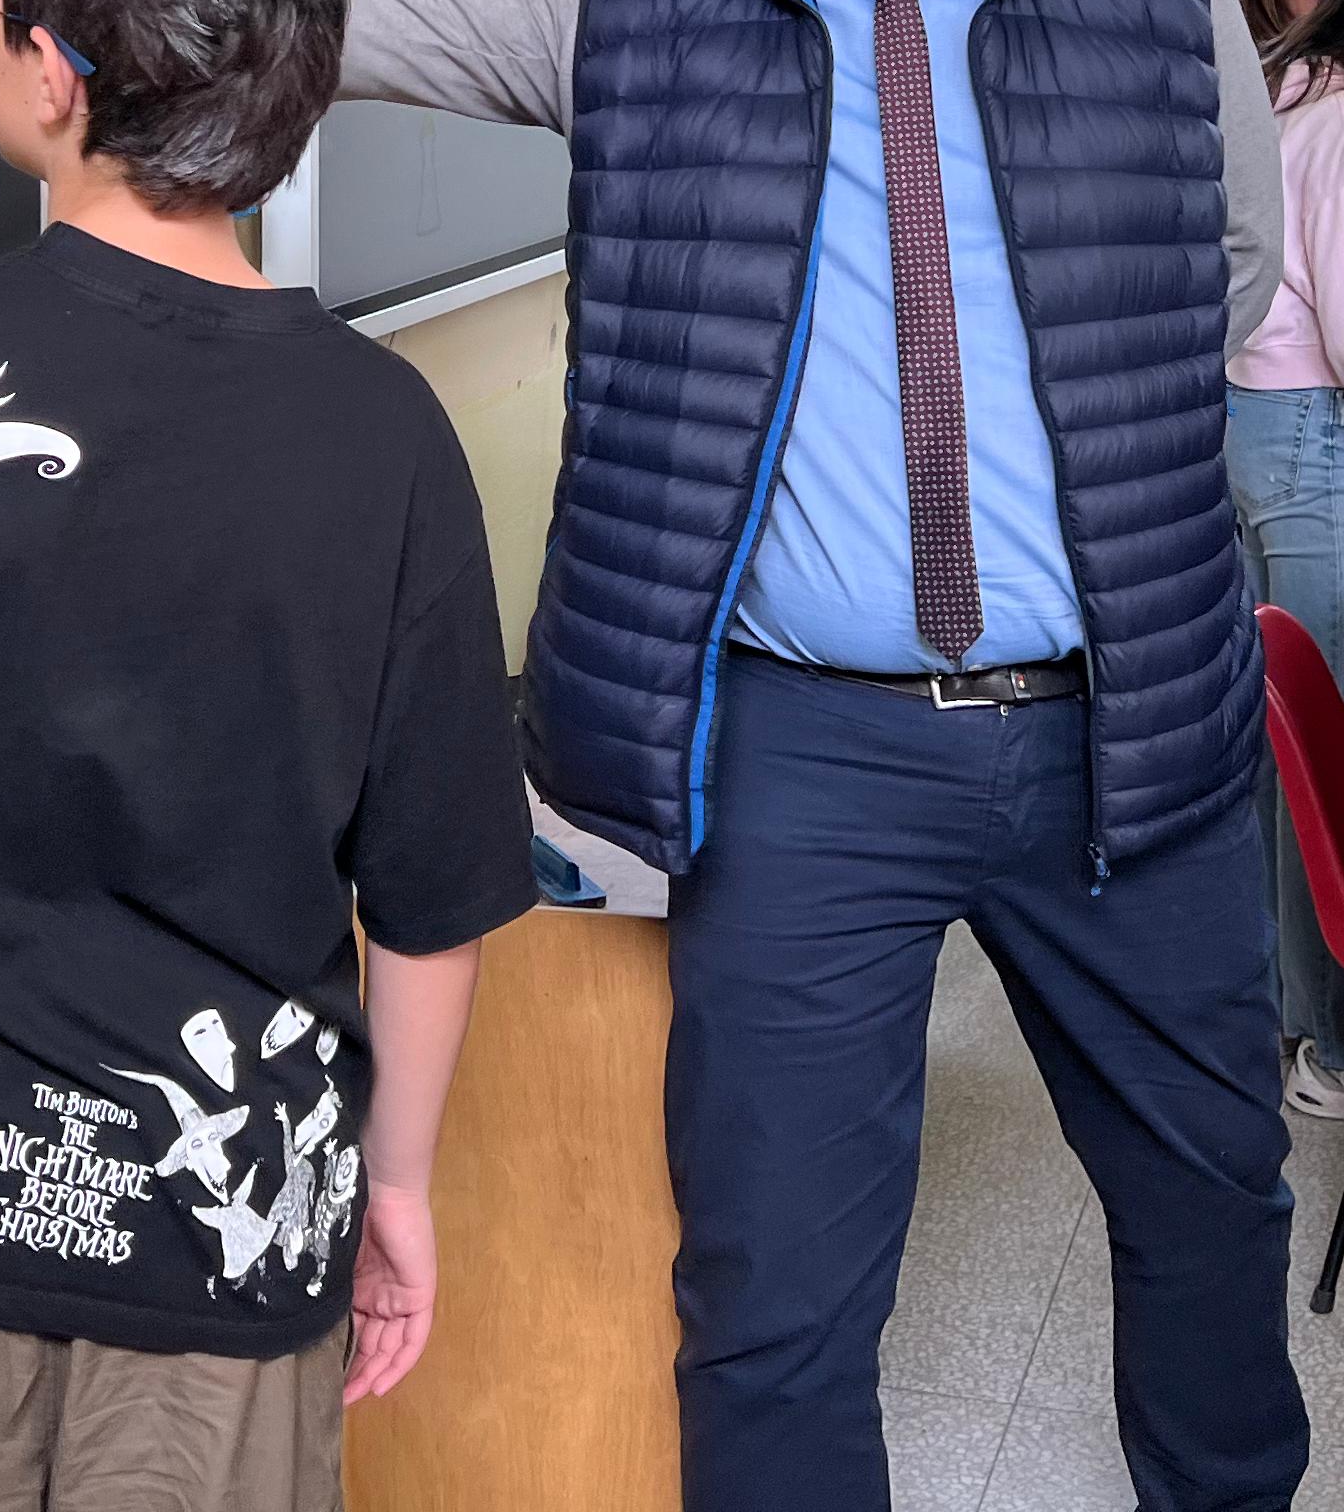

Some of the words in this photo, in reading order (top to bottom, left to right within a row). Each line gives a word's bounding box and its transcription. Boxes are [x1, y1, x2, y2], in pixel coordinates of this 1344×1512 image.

[31, 1082, 65, 1113] TIM
[63, 1090, 138, 1129] BURTON'S
[58, 1115, 98, 1152] THE
[15, 1176, 117, 1228] BEFORE
